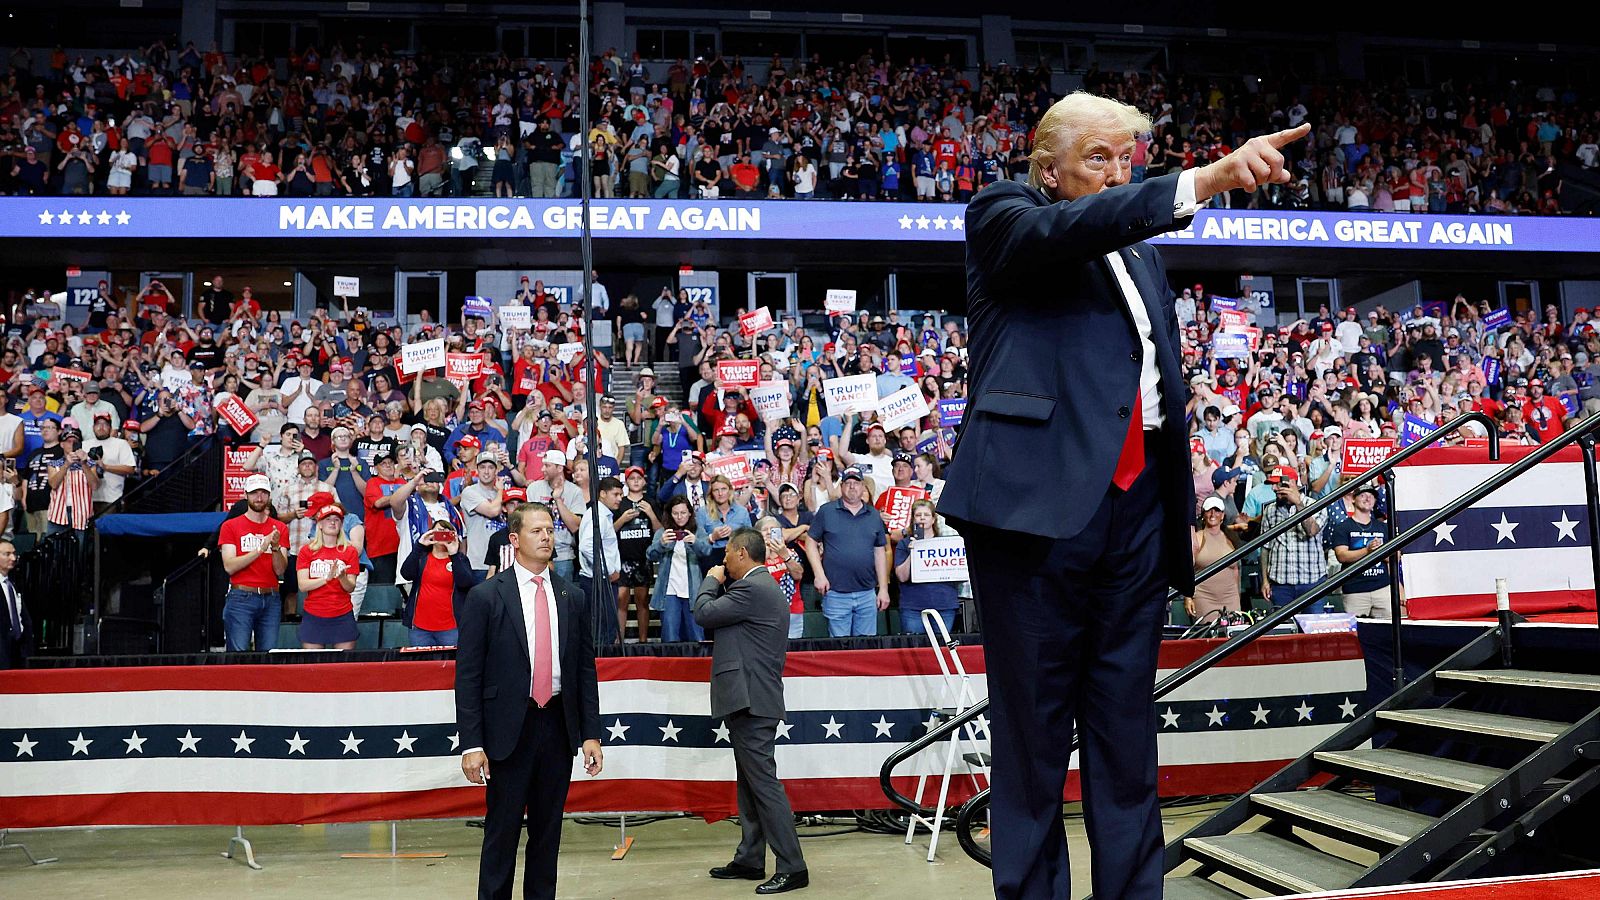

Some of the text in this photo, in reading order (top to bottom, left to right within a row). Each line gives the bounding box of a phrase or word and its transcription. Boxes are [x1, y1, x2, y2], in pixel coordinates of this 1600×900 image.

[279, 205, 761, 231] MAKE AMERICA GREAT AGAIN
[1201, 216, 1330, 241] AMERICA
[1334, 219, 1423, 243] GREAT
[1428, 221, 1514, 245] AGAIN
[685, 288, 712, 303] 122
[466, 299, 491, 307] TRUMP
[1213, 298, 1237, 307] TRUMP
[1484, 309, 1508, 322] TRUMP
[405, 345, 440, 358] TRUMP
[410, 353, 437, 362] VANCE
[452, 364, 478, 372] VANCE
[720, 365, 757, 374] TRUMP
[828, 383, 872, 395] TRUMP
[753, 392, 782, 403] TRUMP
[834, 392, 867, 402] VANCE
[880, 393, 918, 413] TRUMP
[228, 400, 253, 425] TRUMP
[887, 402, 918, 418] VANCE
[227, 407, 247, 428] VANCE
[1406, 421, 1434, 437] TRU
[920, 433, 953, 453] TRUP
[1347, 446, 1391, 456] TRUMP
[620, 529, 651, 539] MISSED ME
[924, 557, 965, 567] VANCE
